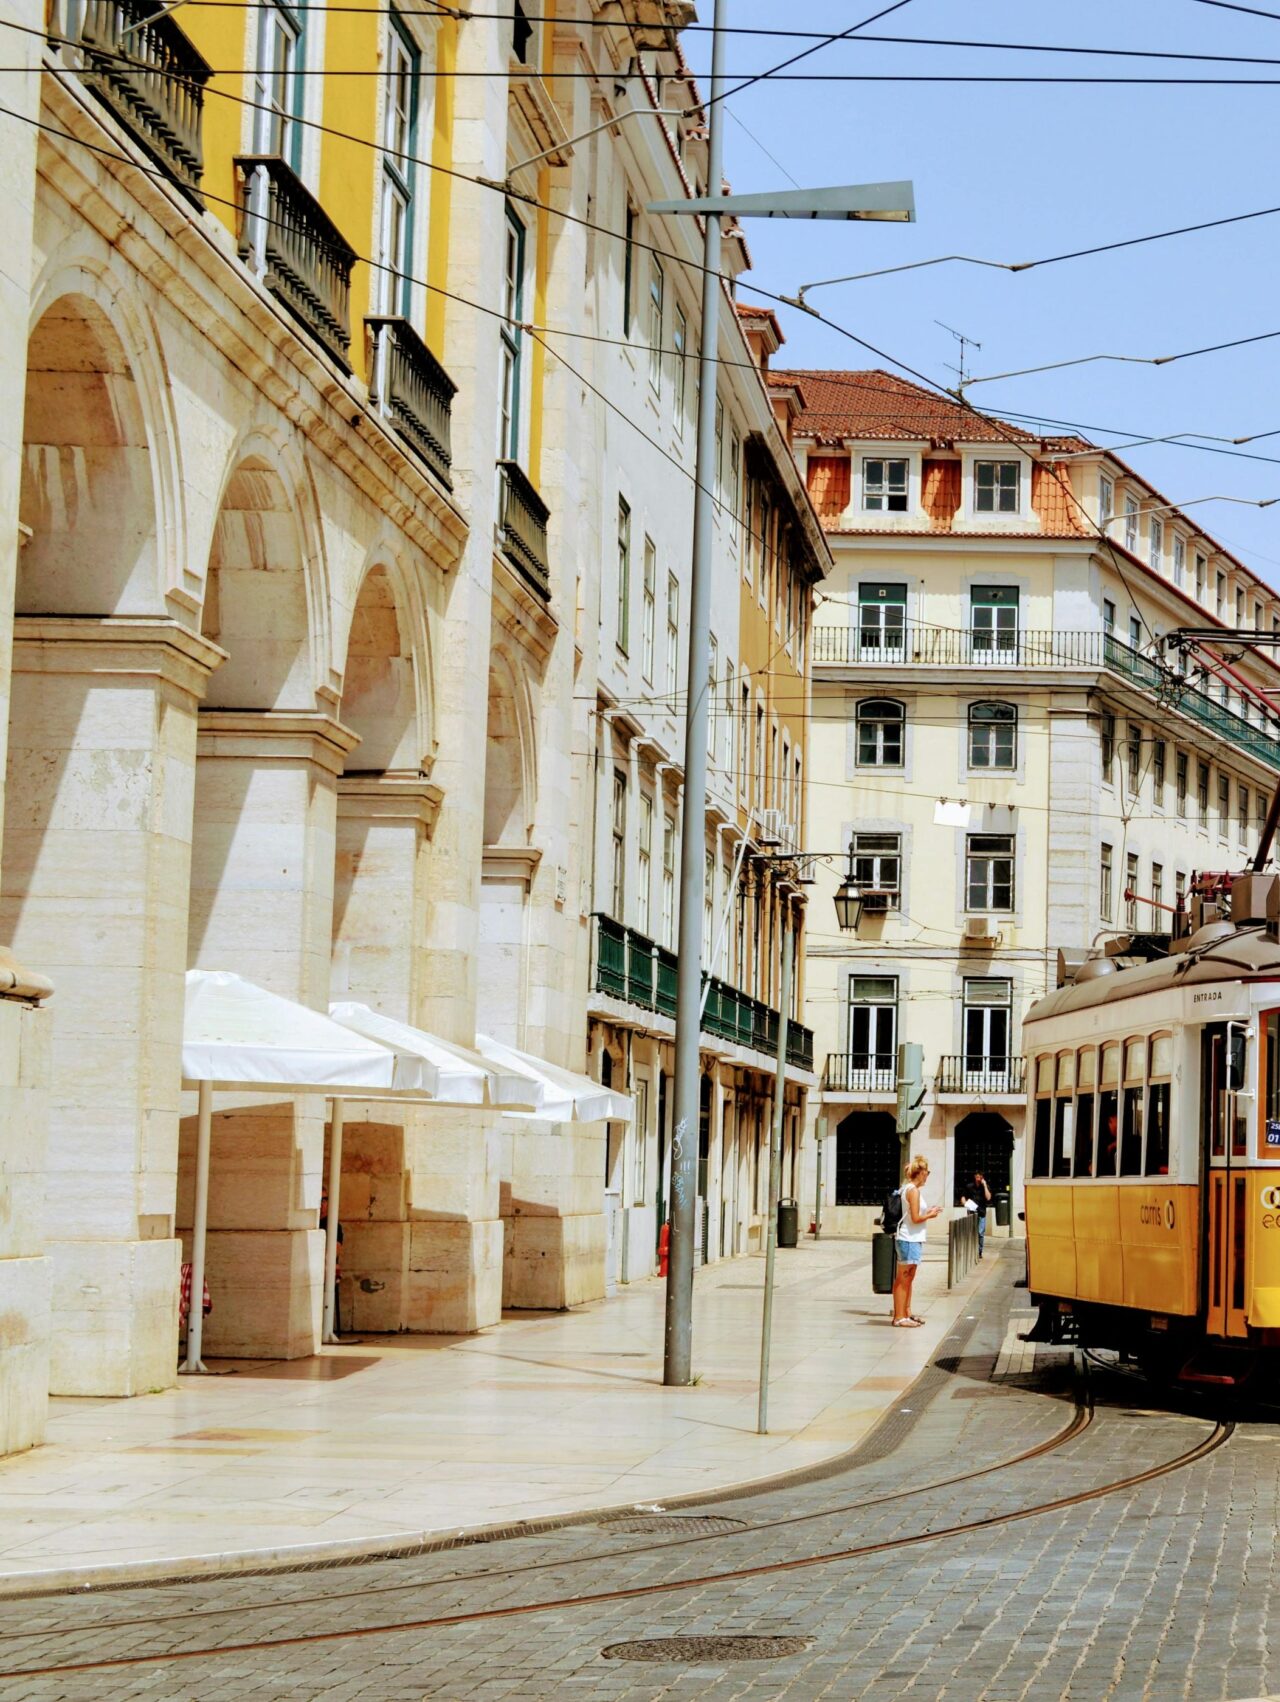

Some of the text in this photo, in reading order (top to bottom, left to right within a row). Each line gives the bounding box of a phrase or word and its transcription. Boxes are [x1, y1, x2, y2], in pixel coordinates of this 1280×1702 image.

[1193, 991, 1223, 1003] ENTRADA
[1267, 1133, 1280, 1144] 01
[1140, 1199, 1162, 1226] carris
